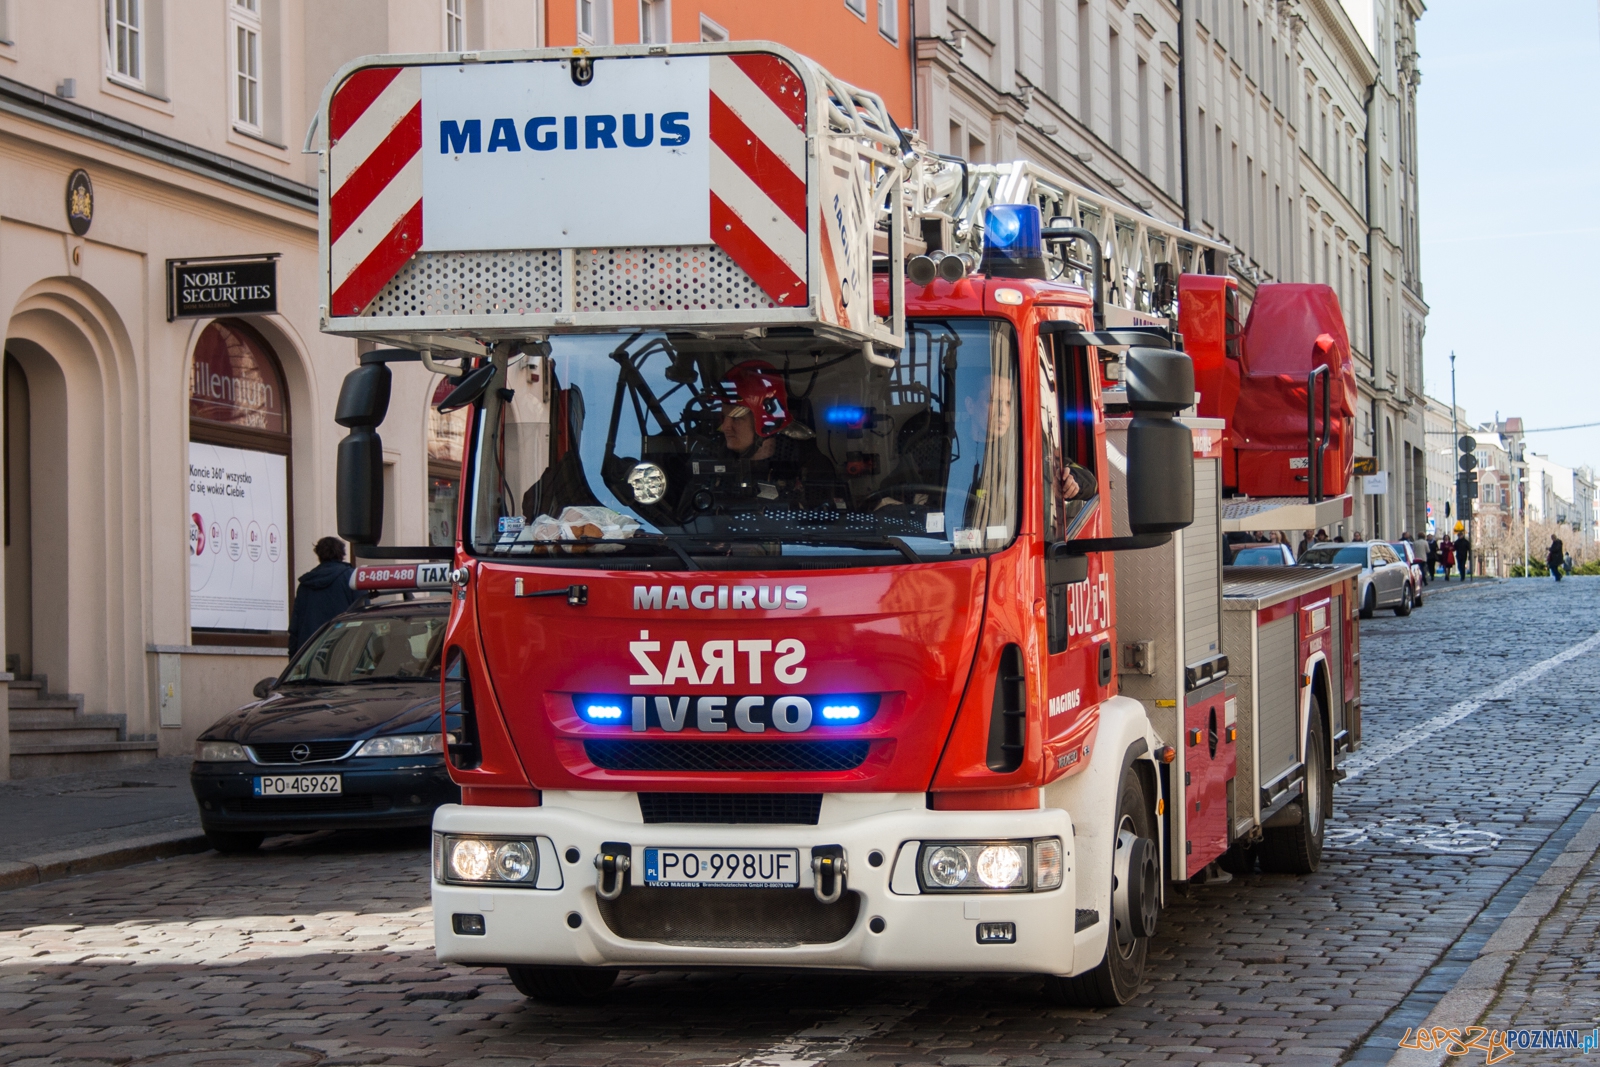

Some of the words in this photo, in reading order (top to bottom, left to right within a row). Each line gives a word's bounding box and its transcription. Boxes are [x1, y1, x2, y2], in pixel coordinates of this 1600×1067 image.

[440, 111, 691, 154] MAGIRUS
[183, 271, 237, 287] NOBLE
[183, 285, 271, 304] SECURITIES
[226, 471, 252, 485] wszystko
[226, 484, 245, 498] Ciebie
[358, 569, 415, 582] 8-480-480
[633, 585, 807, 610] MAGIRUS
[1048, 688, 1080, 717] MAGIRUS
[632, 696, 813, 733] IVECO
[263, 777, 285, 793] PO
[291, 776, 338, 793] 4G962
[647, 868, 657, 877] PL
[662, 852, 700, 879] PO
[710, 853, 791, 880] 998UF
